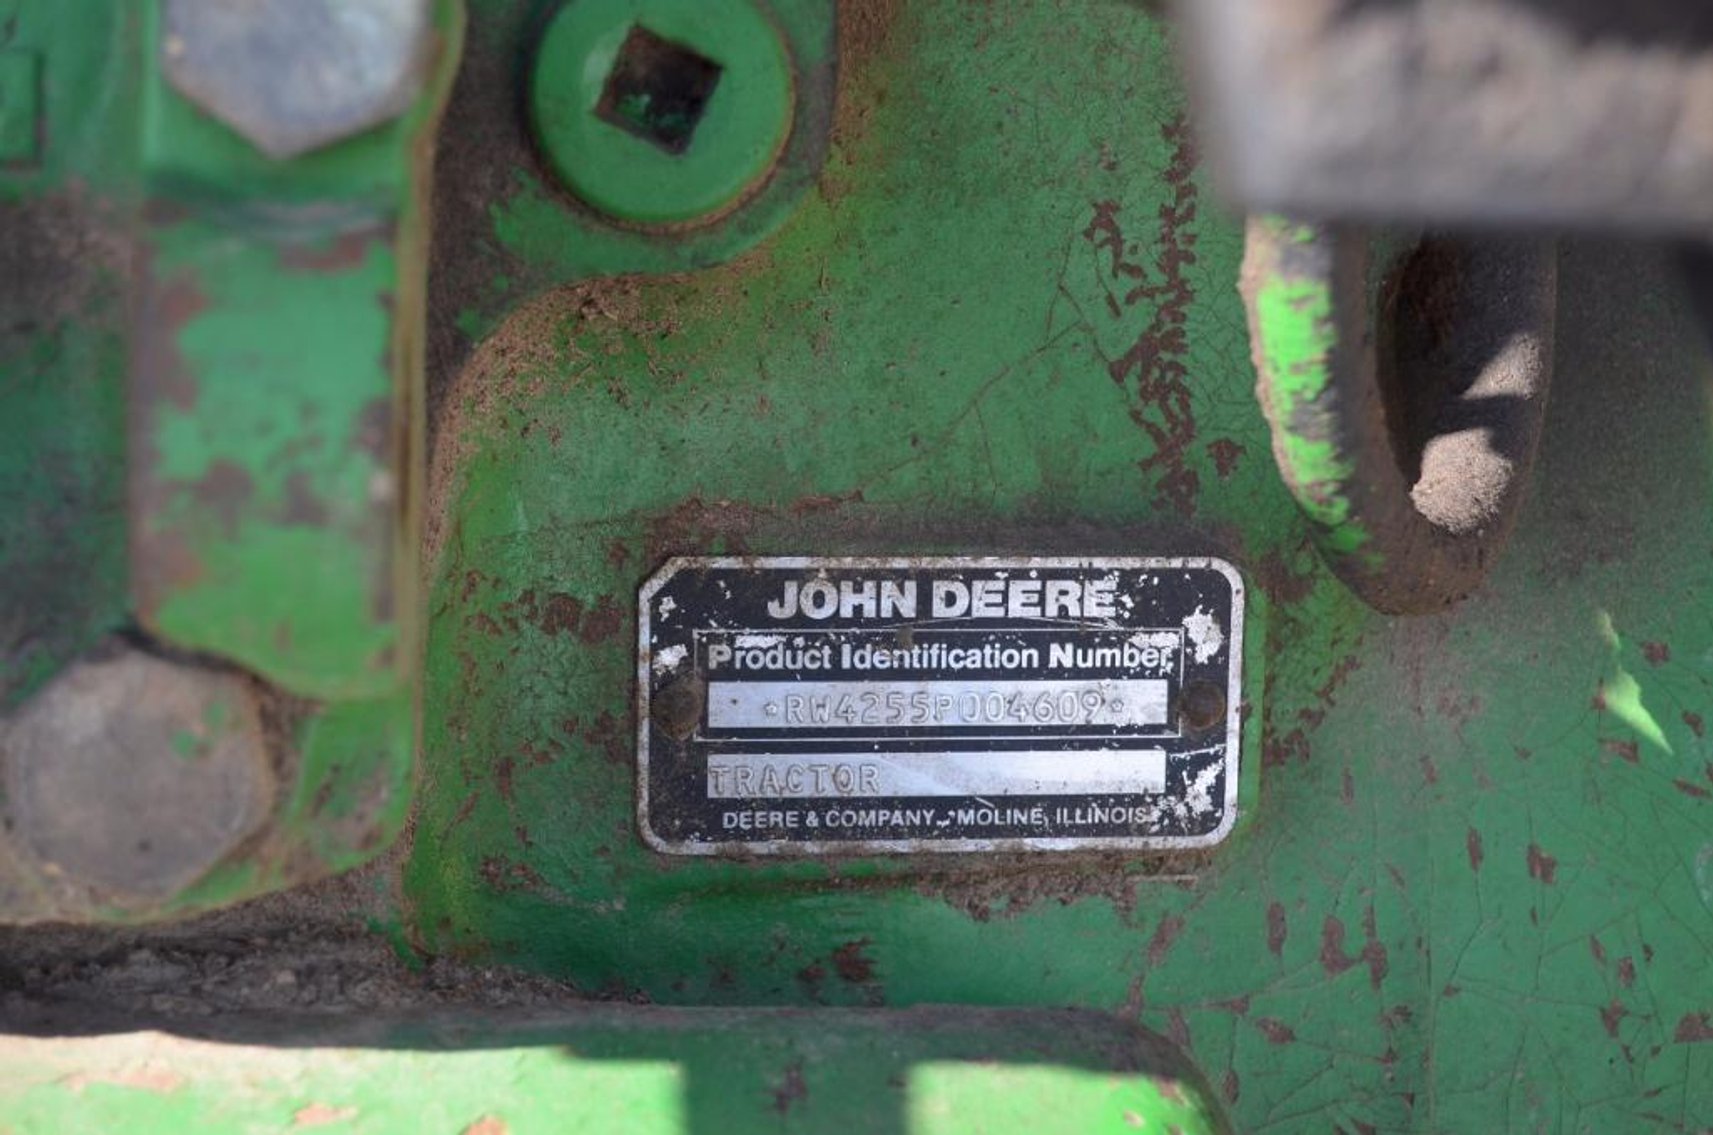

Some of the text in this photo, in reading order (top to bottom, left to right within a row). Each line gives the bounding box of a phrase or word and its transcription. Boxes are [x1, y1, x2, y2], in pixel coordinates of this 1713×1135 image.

[767, 579, 1118, 619] JOHN DEERE
[708, 641, 1169, 670] Product Identification Number
[709, 764, 881, 796] TRACTOR
[722, 810, 799, 829] DEERE
[805, 809, 819, 828] &
[825, 809, 936, 828] COMPANY
[1056, 806, 1150, 825] ILLINOIS
